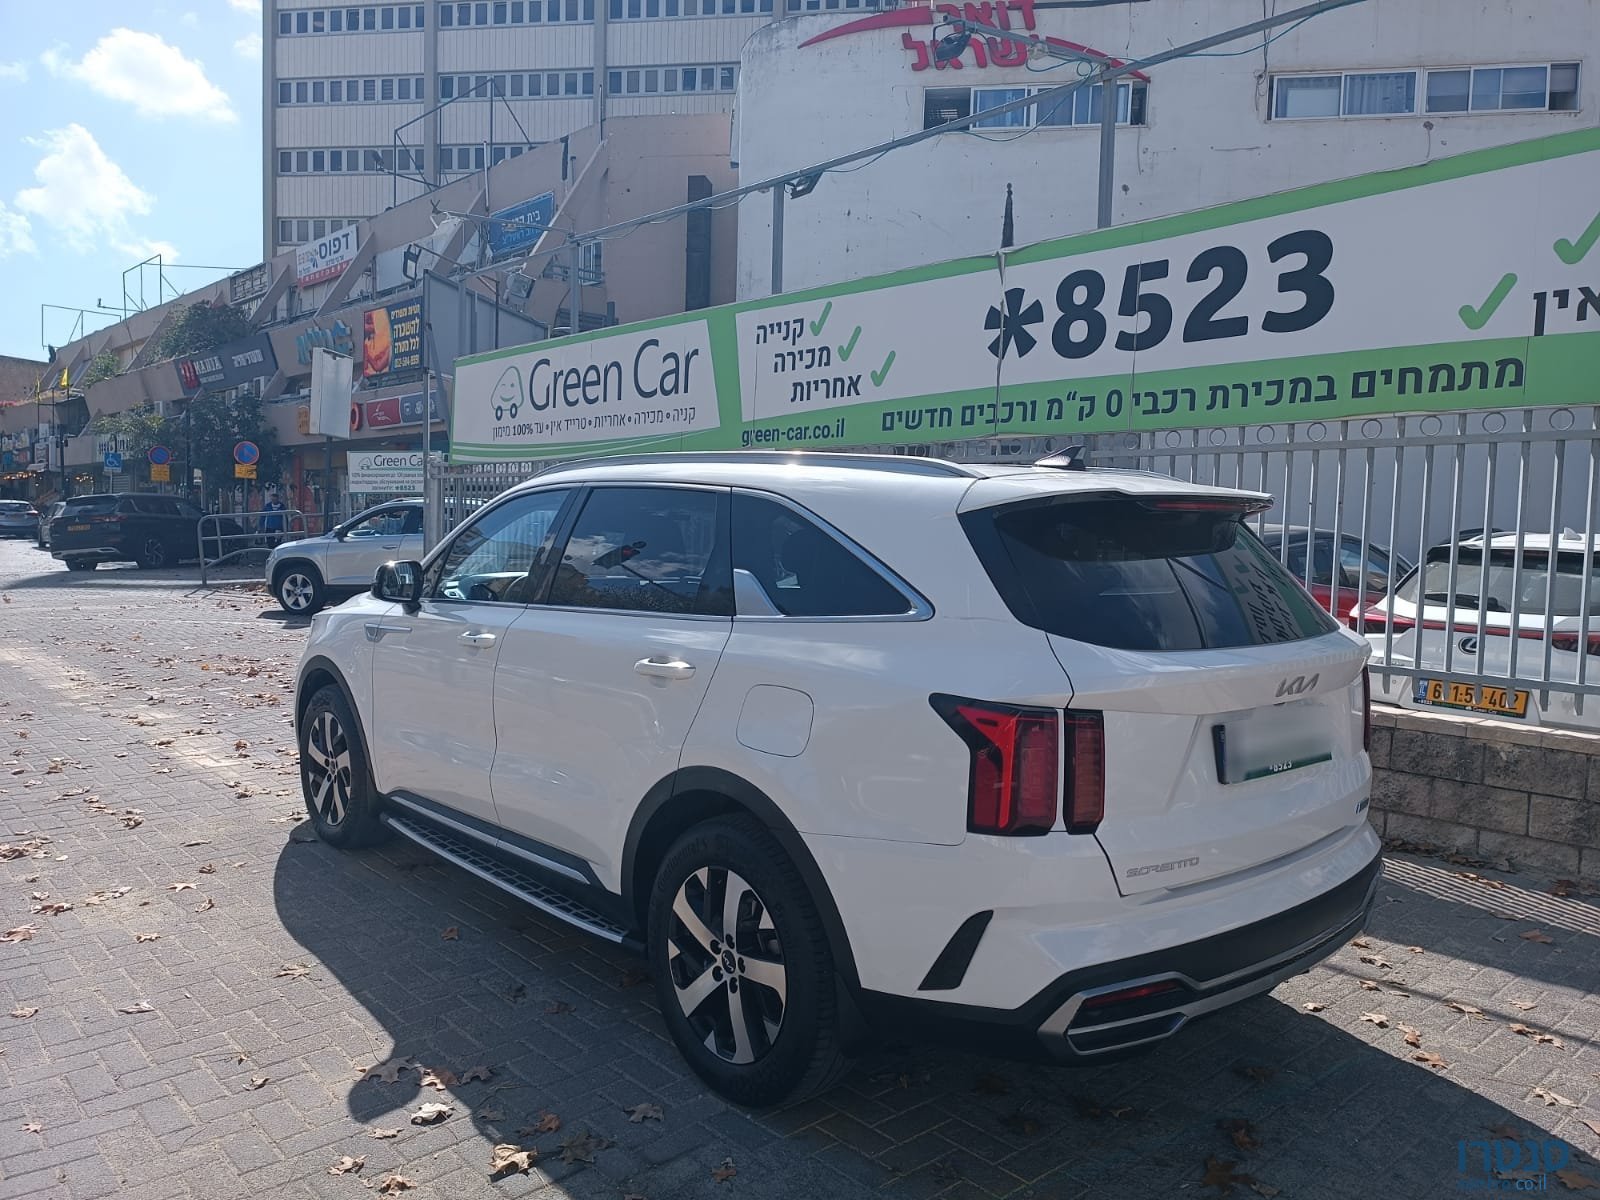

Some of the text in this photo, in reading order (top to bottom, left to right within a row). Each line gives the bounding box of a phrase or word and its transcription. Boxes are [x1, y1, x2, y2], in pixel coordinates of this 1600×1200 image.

[936, 0, 1036, 33] דואר
[318, 232, 350, 260] דפוס
[393, 316, 420, 339] להשכרה
[756, 318, 805, 346] קנייה
[409, 336, 420, 350] לכל
[773, 345, 831, 373] מכירה
[529, 338, 699, 411] Green Car
[790, 374, 862, 403] אחריות
[1351, 357, 1524, 399] מתמחים
[1106, 388, 1123, 418] 0
[1132, 388, 1197, 416] רכבי
[1206, 374, 1337, 410] במכירת
[492, 406, 696, 441] קניה מכירה אחריות טרייד אין עד 100% מימון
[881, 406, 953, 432] חדשים
[960, 399, 1037, 427] ורכבים
[741, 418, 845, 448] green-car.co.il
[374, 455, 423, 467] Green Ca
[1126, 856, 1200, 878] SORENTO
